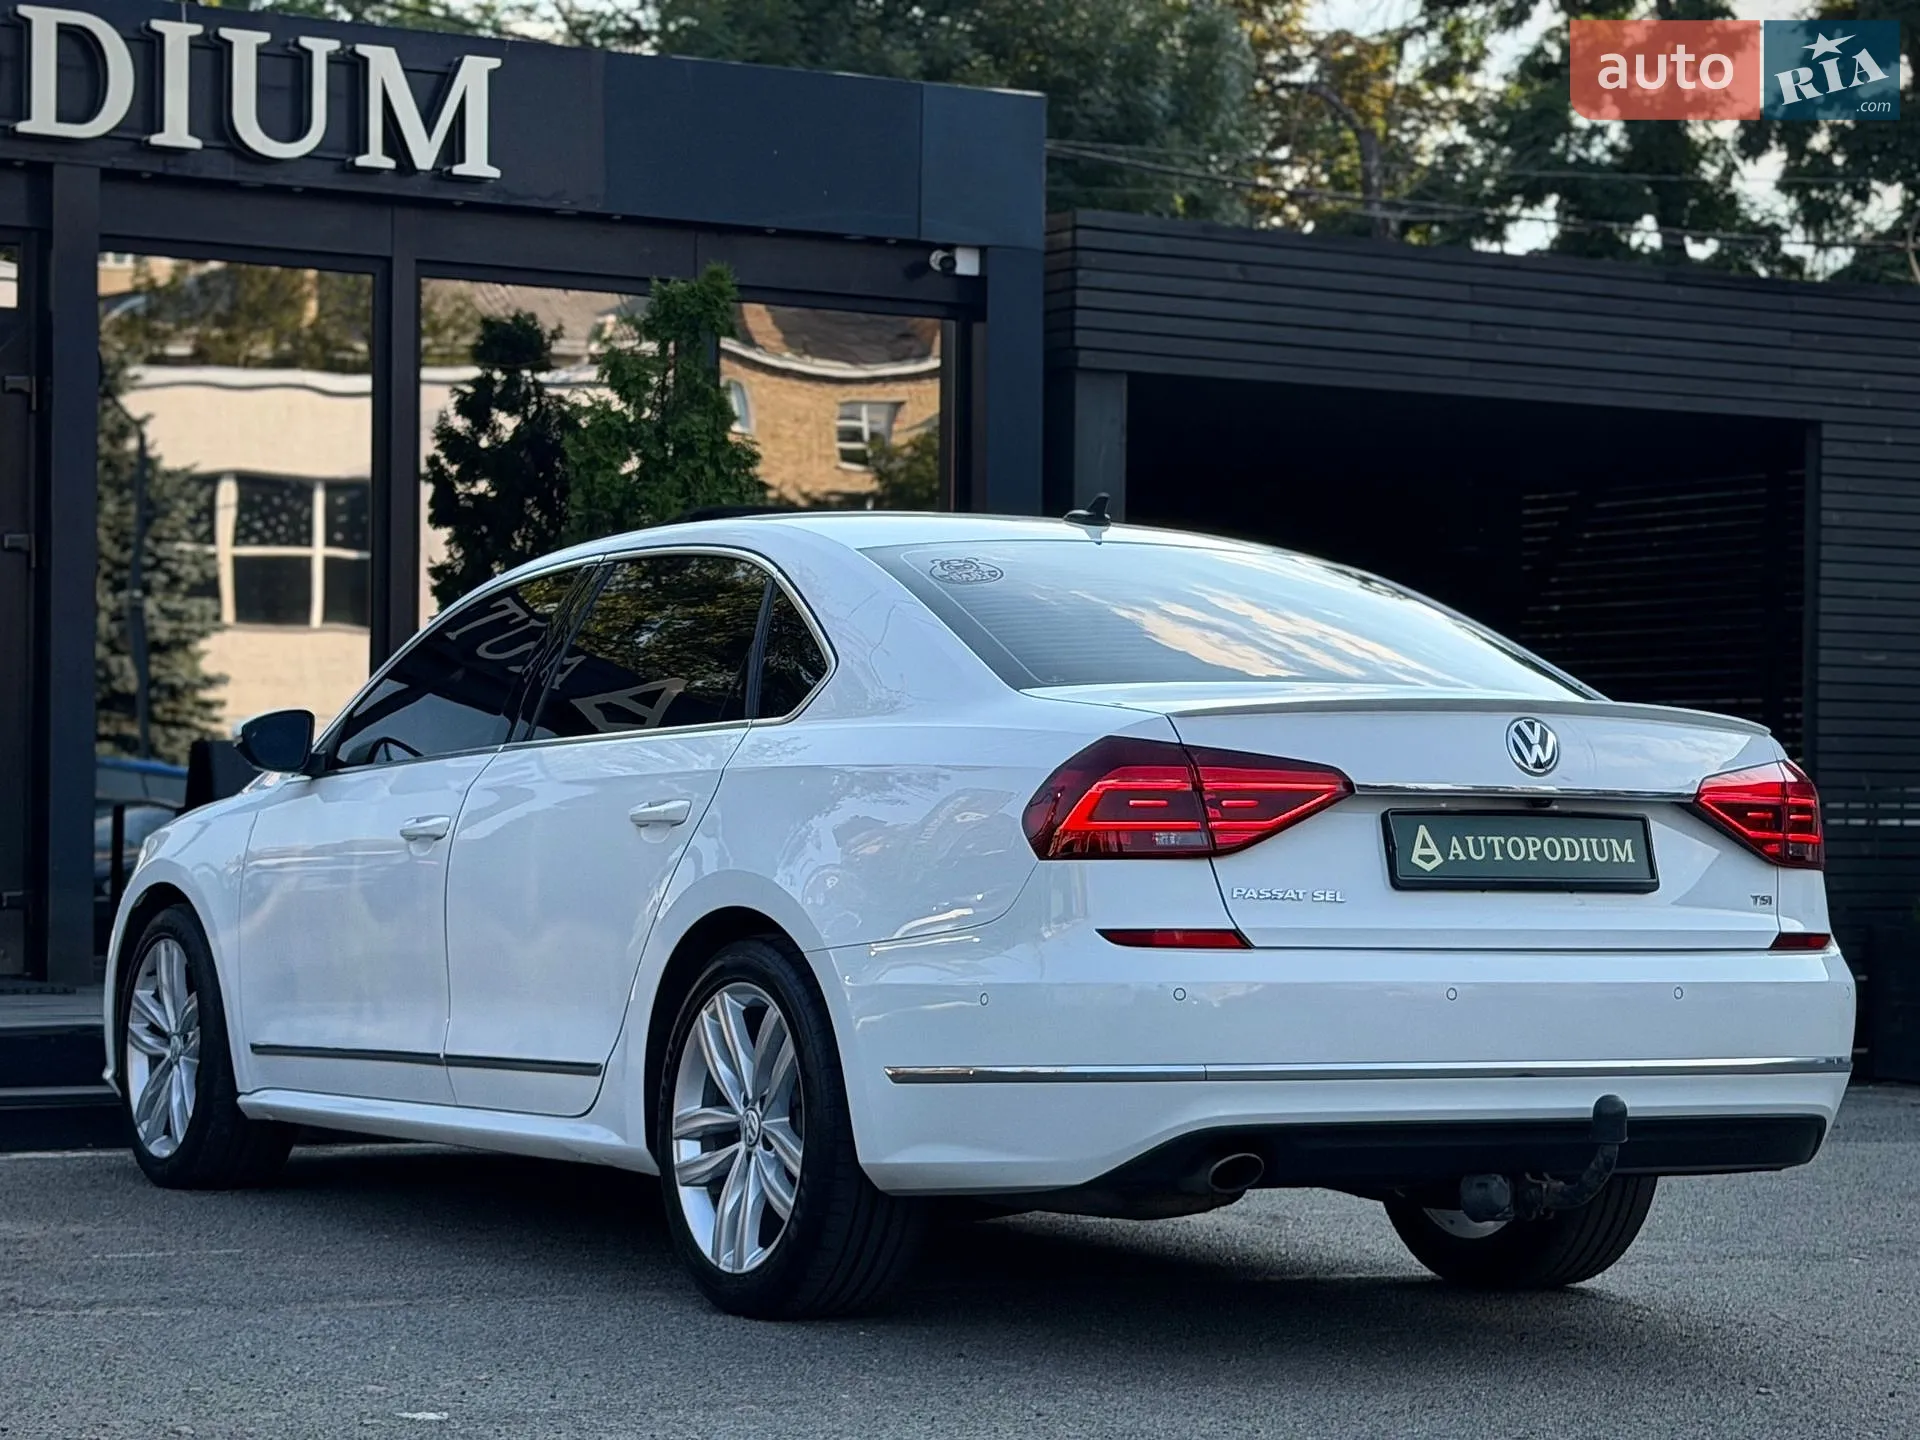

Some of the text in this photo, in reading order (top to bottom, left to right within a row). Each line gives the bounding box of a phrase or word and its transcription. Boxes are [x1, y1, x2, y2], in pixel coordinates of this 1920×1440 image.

[16, 4, 501, 178] DIUM
[1449, 836, 1636, 863] AUTOPODIUM
[1232, 887, 1346, 903] PASSAT SEL
[1750, 894, 1772, 905] TSI
